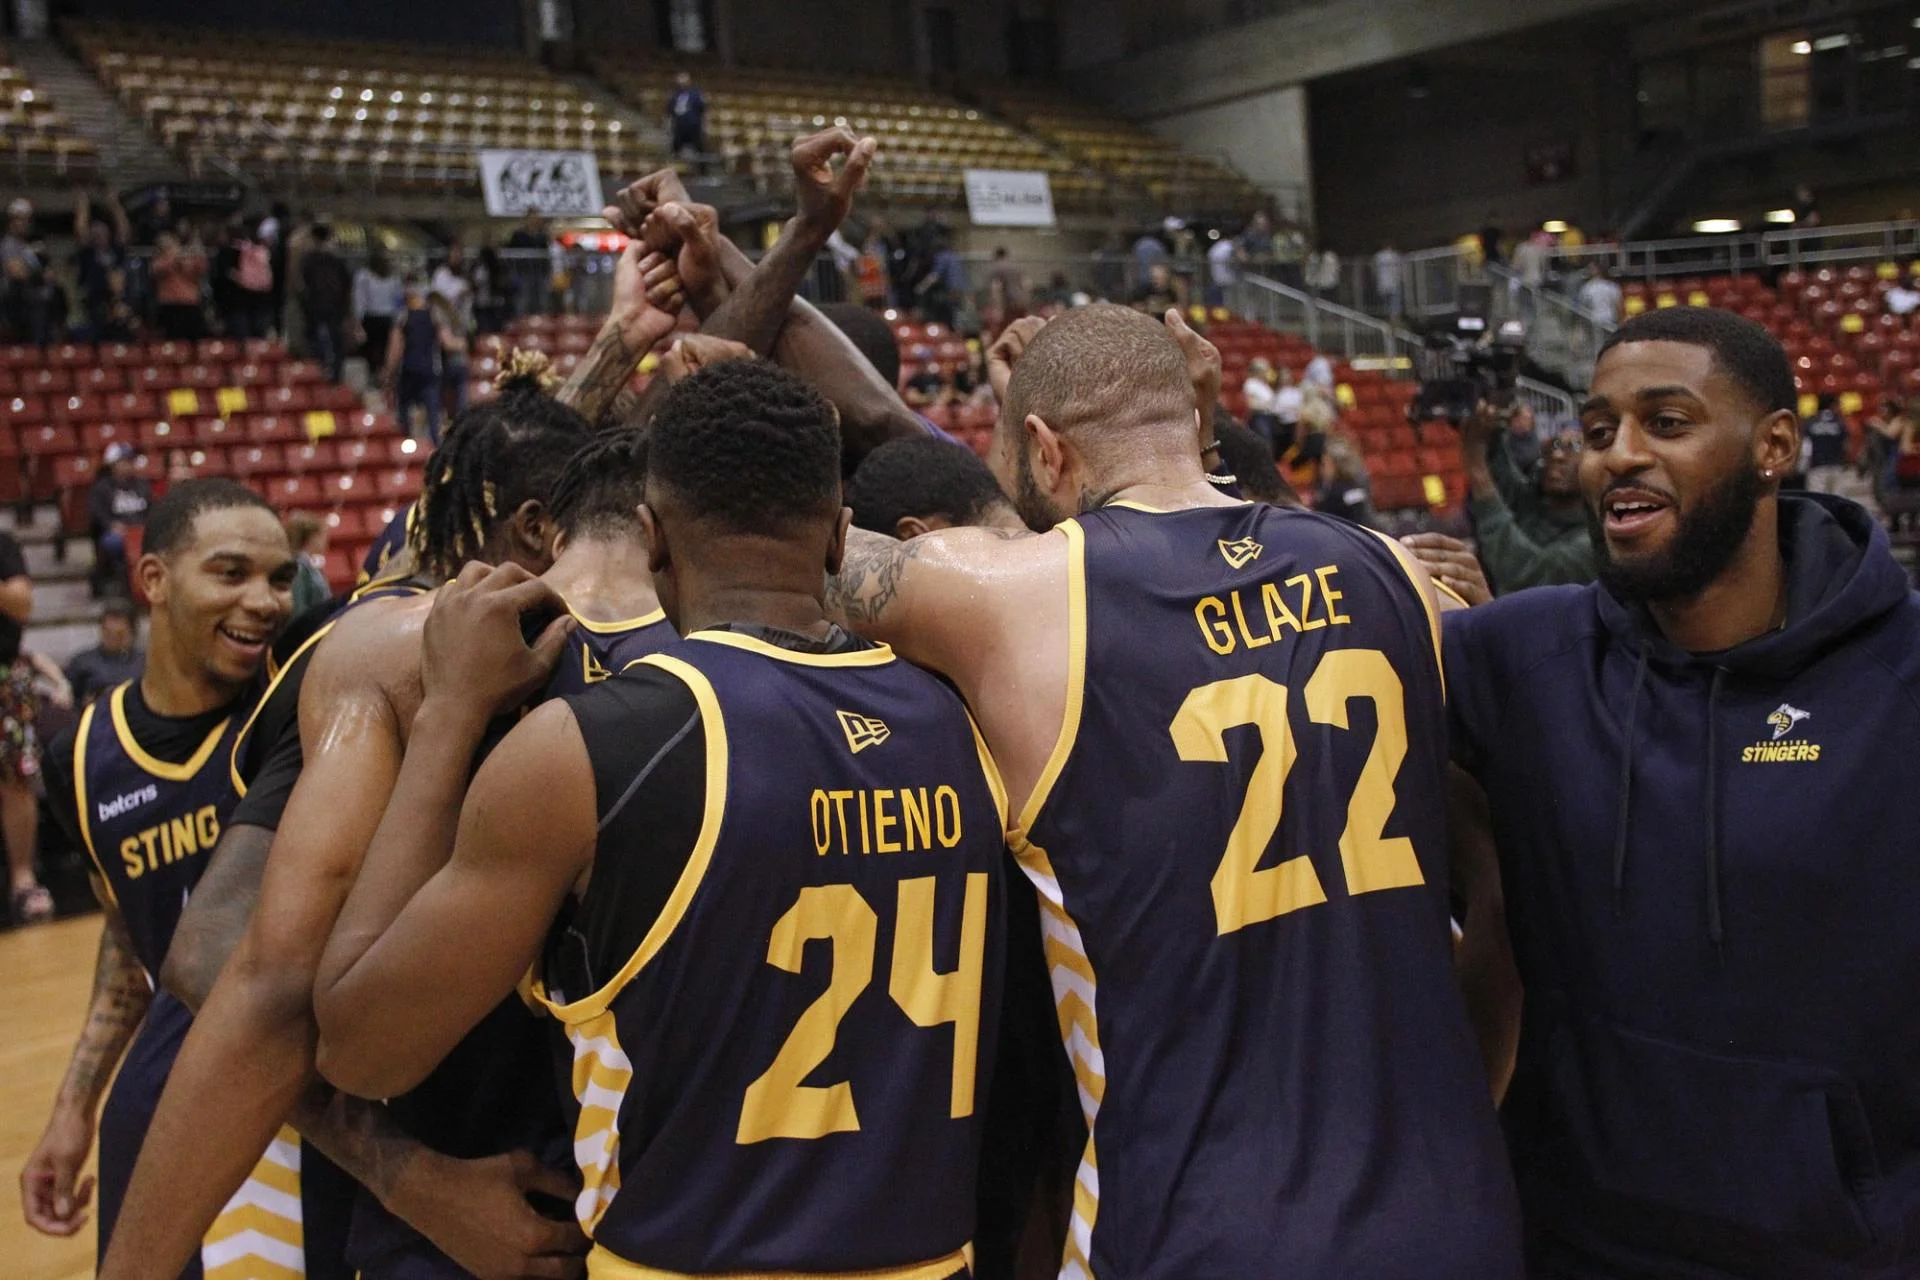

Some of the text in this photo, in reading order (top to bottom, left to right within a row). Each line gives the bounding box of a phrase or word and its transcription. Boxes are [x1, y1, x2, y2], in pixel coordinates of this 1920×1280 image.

[1194, 564, 1351, 655] GLAZE
[1168, 648, 1426, 937] 22
[1741, 744, 1821, 763] STINGERS
[810, 784, 962, 857] OTIENO
[735, 872, 989, 1145] 24
